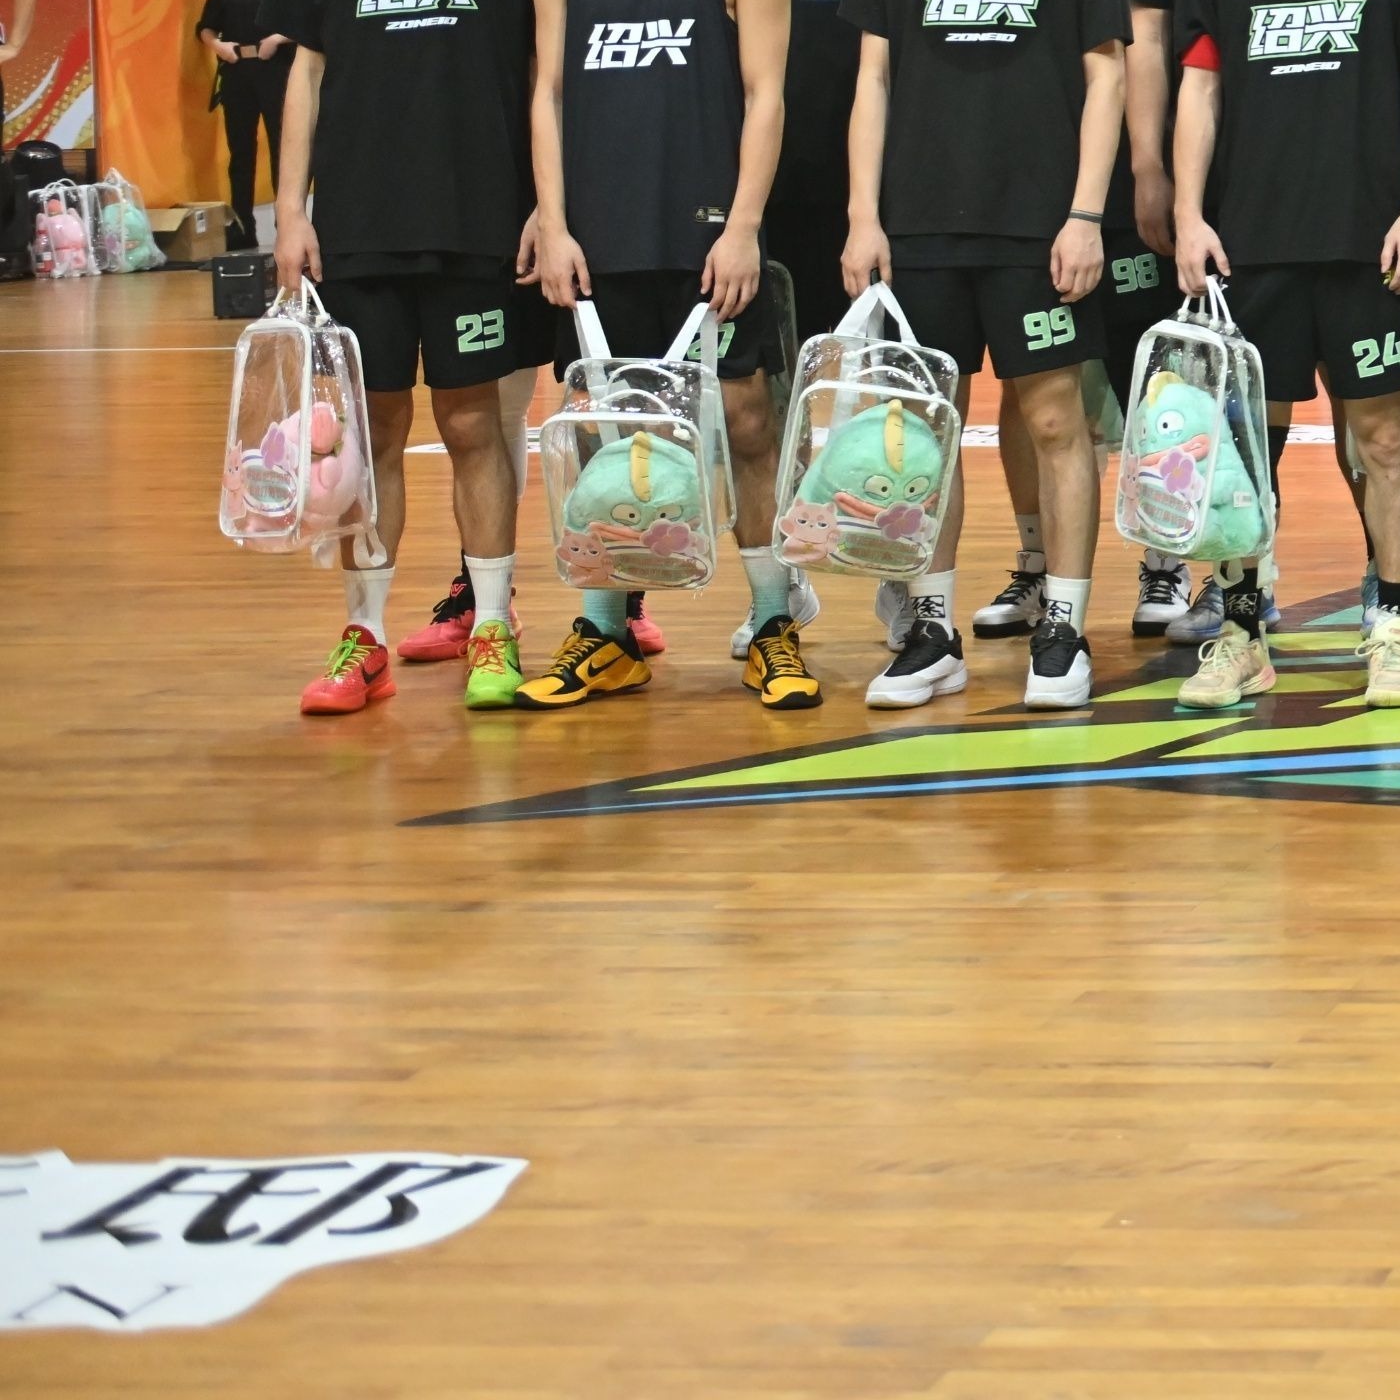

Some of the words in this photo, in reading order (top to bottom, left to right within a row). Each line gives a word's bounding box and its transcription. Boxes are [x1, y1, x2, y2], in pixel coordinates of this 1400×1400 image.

[583, 18, 695, 70] 绍兴
[1248, 0, 1367, 61] 绍兴
[1111, 253, 1160, 293] 98
[456, 308, 506, 353] 23
[1023, 305, 1076, 351] 99
